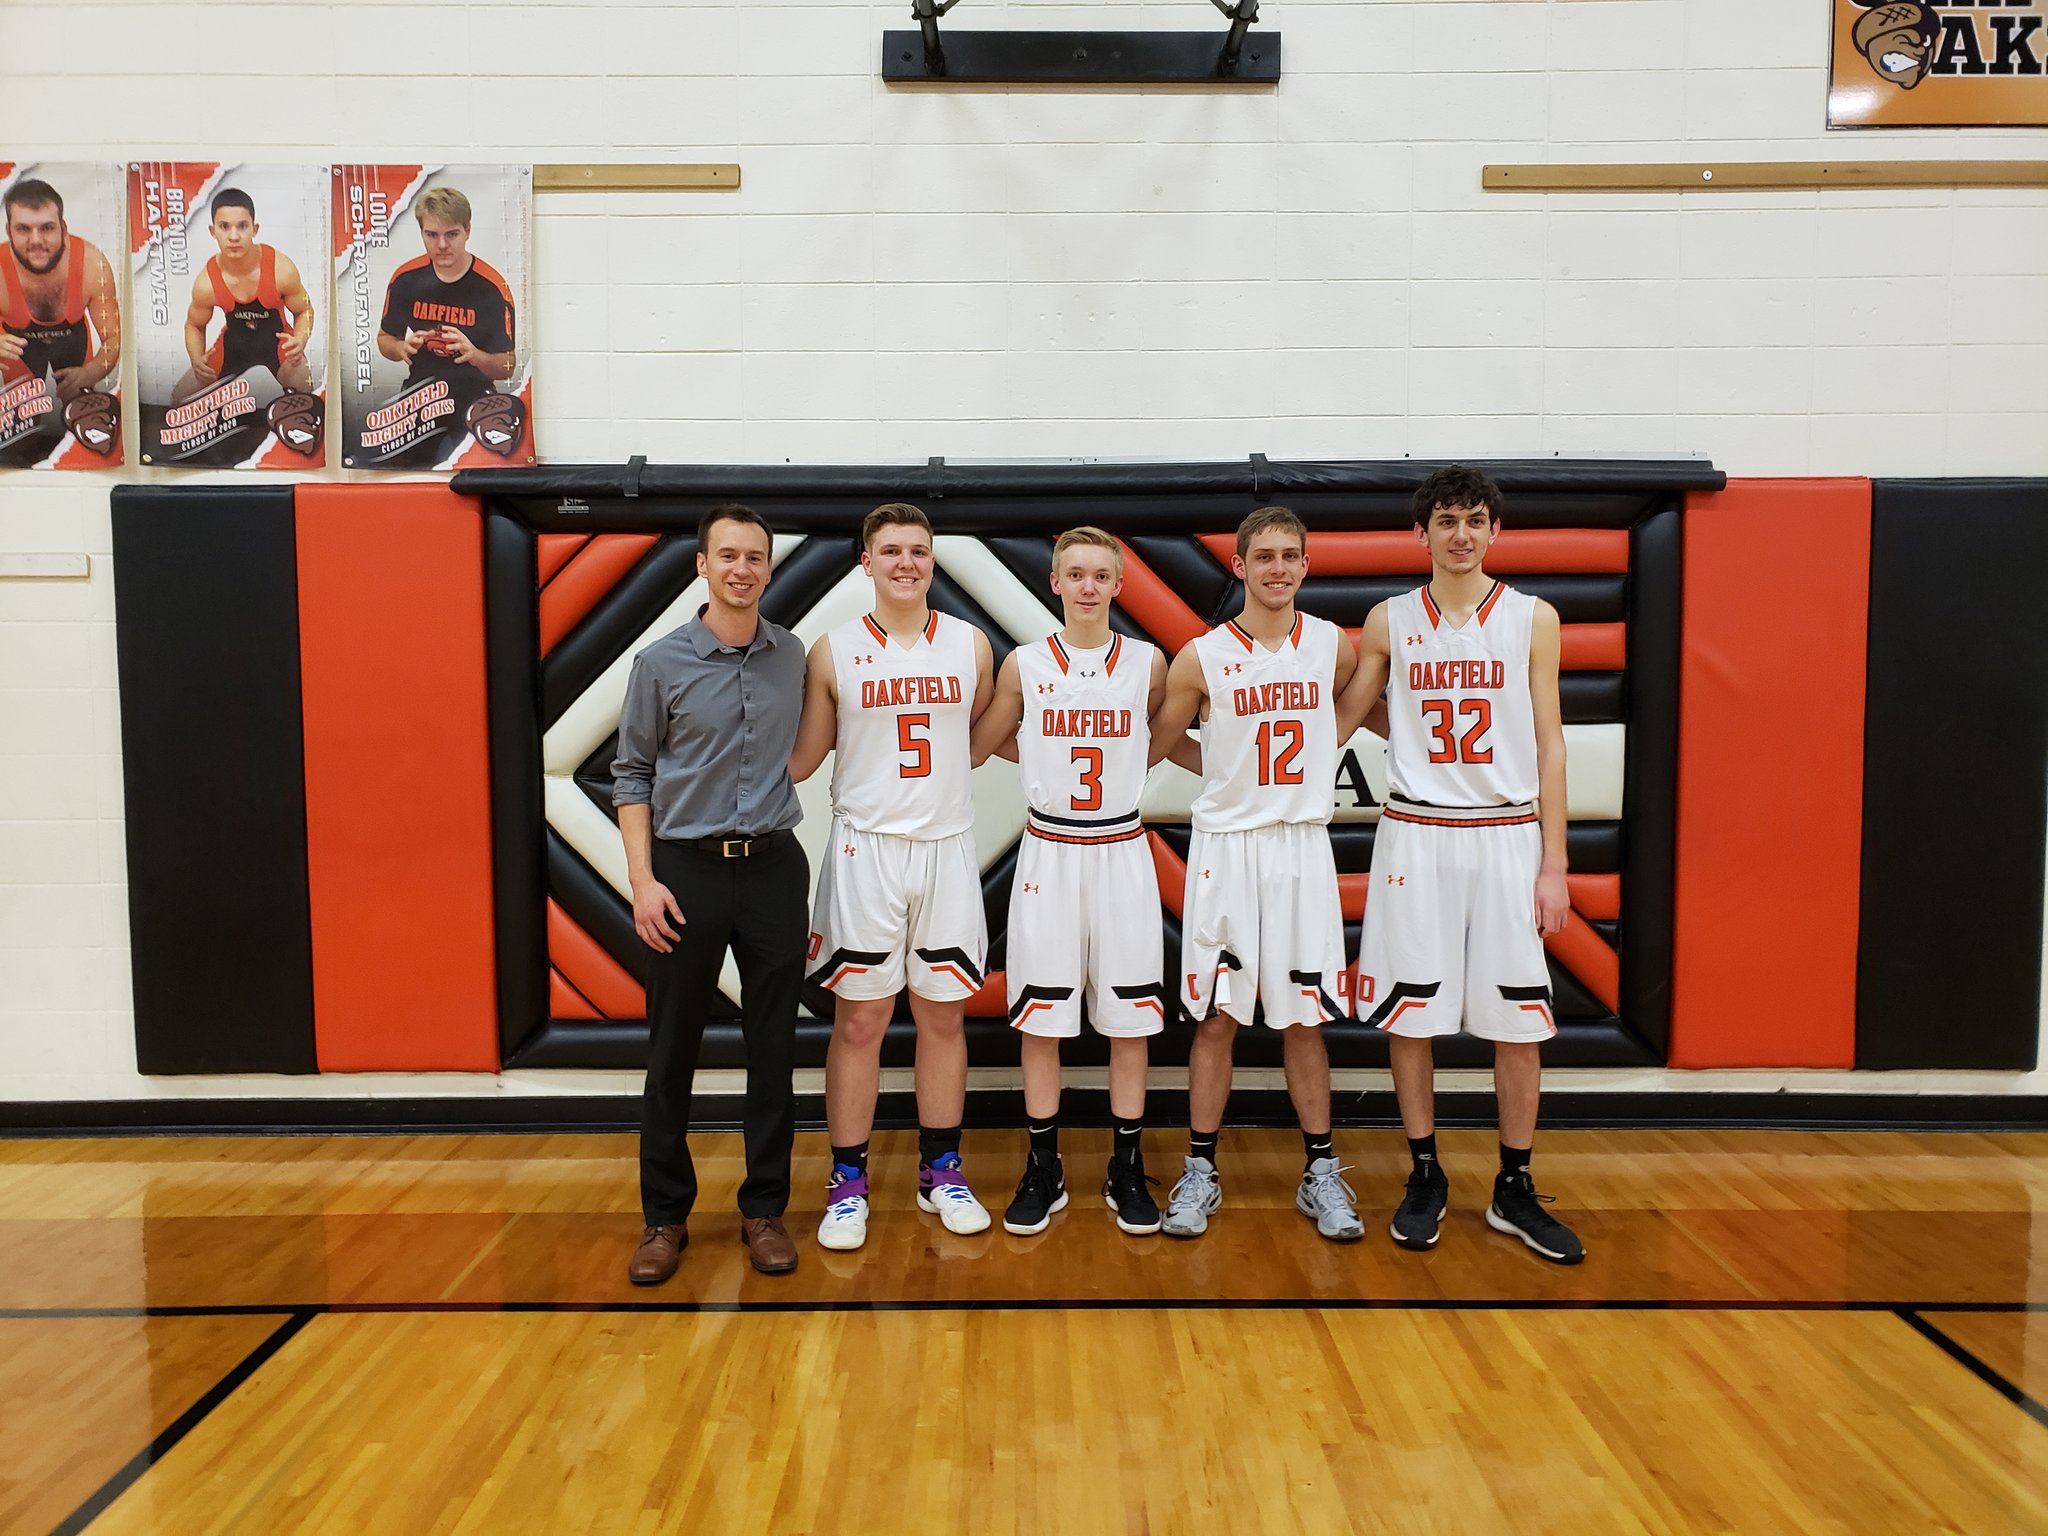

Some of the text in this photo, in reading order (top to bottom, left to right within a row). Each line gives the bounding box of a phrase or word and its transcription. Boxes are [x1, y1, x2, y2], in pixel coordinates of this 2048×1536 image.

[1932, 17, 2048, 74] AK
[166, 188, 189, 276] BRENDAN
[369, 192, 389, 248] LOUIE
[145, 181, 168, 326] HARTWIG
[350, 185, 372, 393] SCHRAUFNAGEL
[413, 301, 476, 327] OAKFIELD
[160, 397, 256, 445] MIGHTY OAKS
[166, 379, 249, 427] OAKFIELD
[361, 399, 455, 447] MIGHTY OAKS
[366, 380, 448, 430] OAKFIELD
[381, 436, 405, 454] CLASS
[861, 675, 962, 709] OAKFIELD
[1233, 681, 1319, 717] OAKFIELD
[1409, 660, 1504, 690] OAKFIELD
[896, 712, 931, 779] 5
[1041, 709, 1132, 738] OAKFIELD
[1421, 698, 1493, 764] 32
[1254, 719, 1304, 787] 12
[1070, 746, 1102, 811] 3
